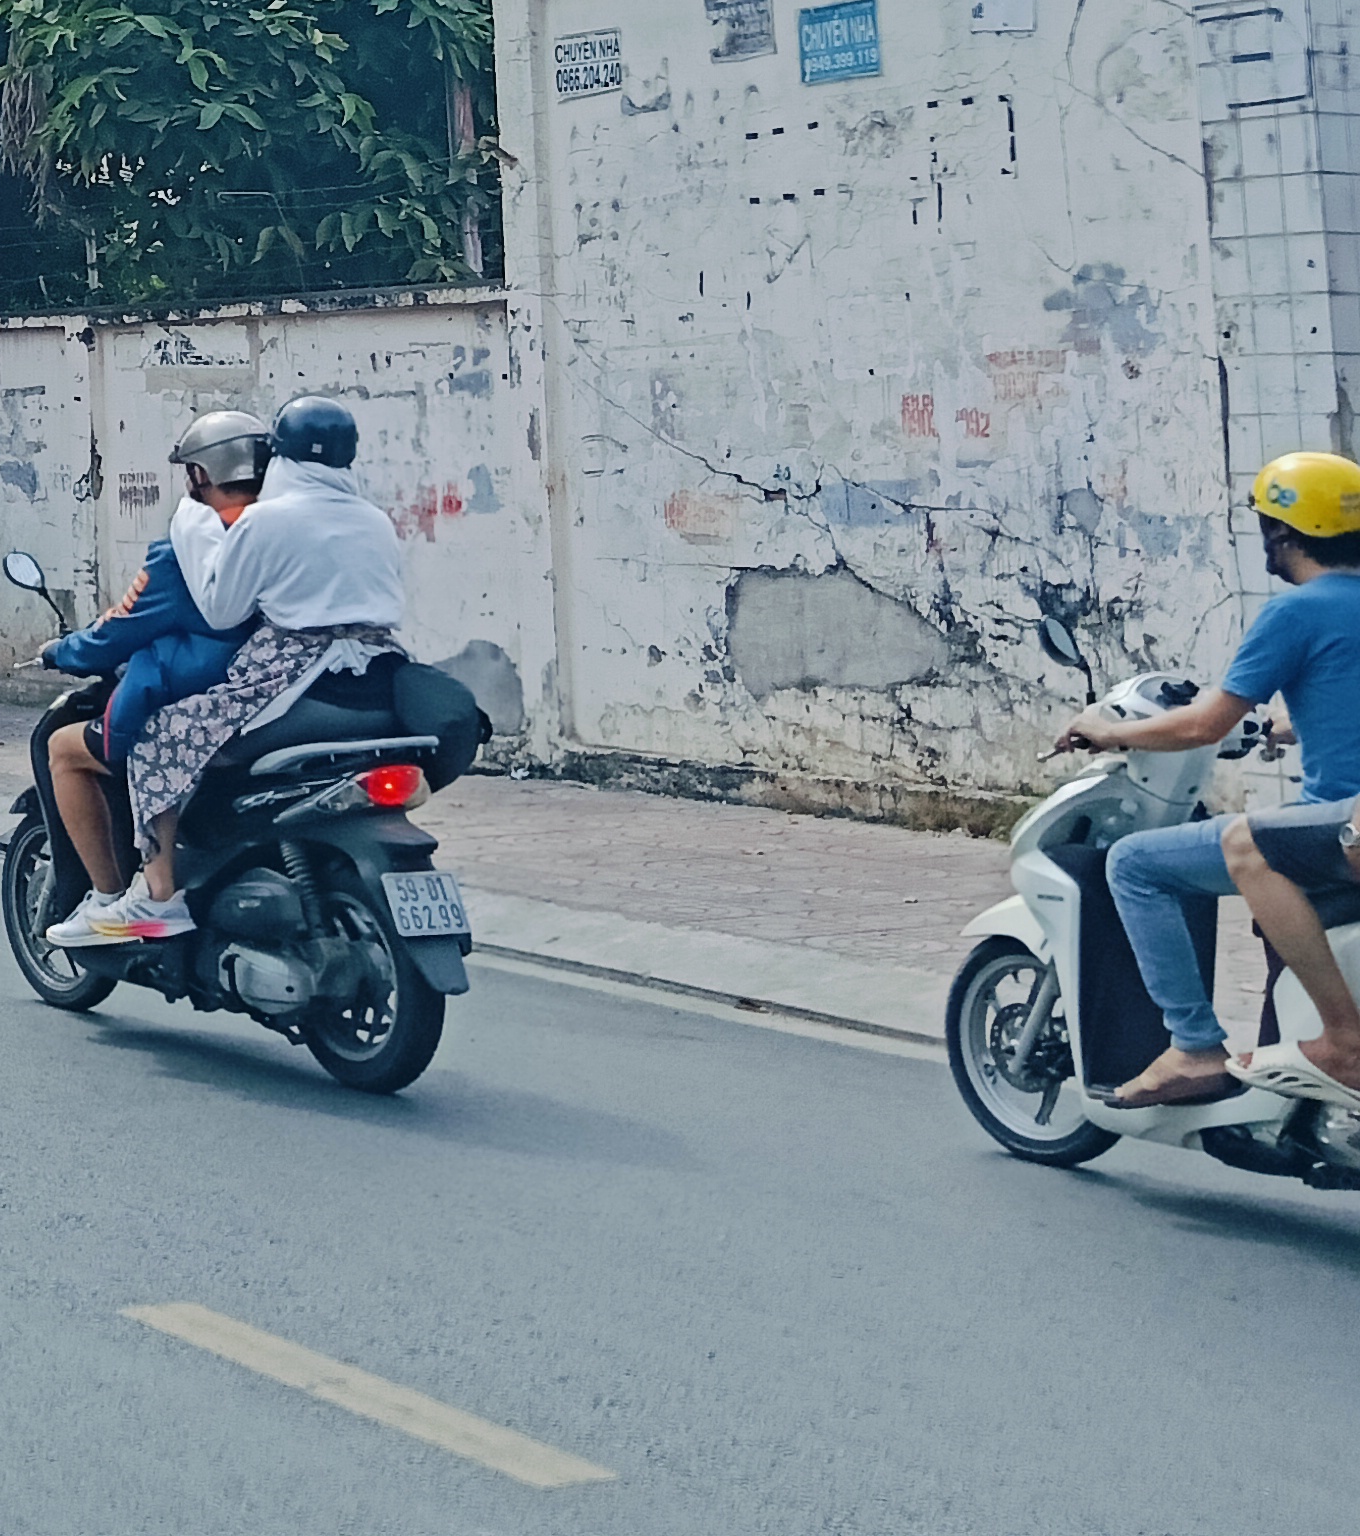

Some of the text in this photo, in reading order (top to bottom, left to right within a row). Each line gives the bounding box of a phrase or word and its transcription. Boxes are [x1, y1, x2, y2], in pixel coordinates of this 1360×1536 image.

[555, 62, 623, 93] 0966.204.240
[394, 876, 448, 902] 59-D1
[397, 903, 464, 930] 662.99
